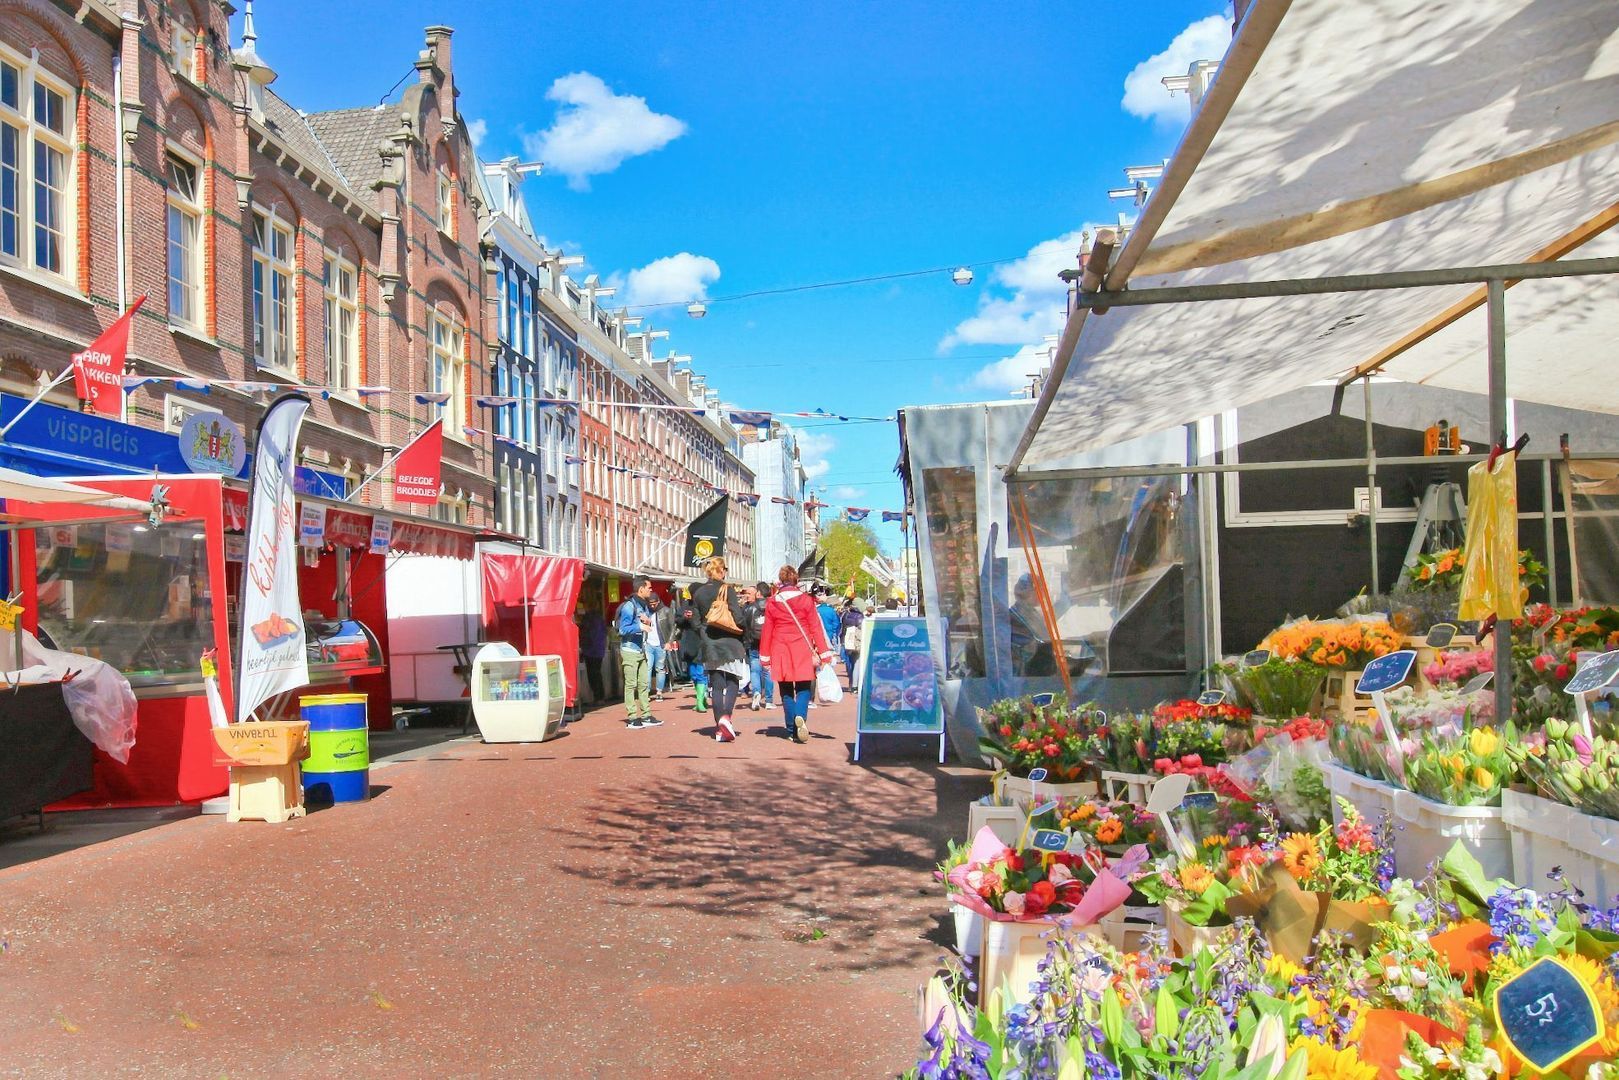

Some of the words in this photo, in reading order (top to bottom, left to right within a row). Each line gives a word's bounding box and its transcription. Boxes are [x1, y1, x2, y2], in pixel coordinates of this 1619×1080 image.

[48, 415, 139, 456] vispaleis
[399, 475, 435, 486] BELEGDE
[396, 486, 437, 497] BROODJES
